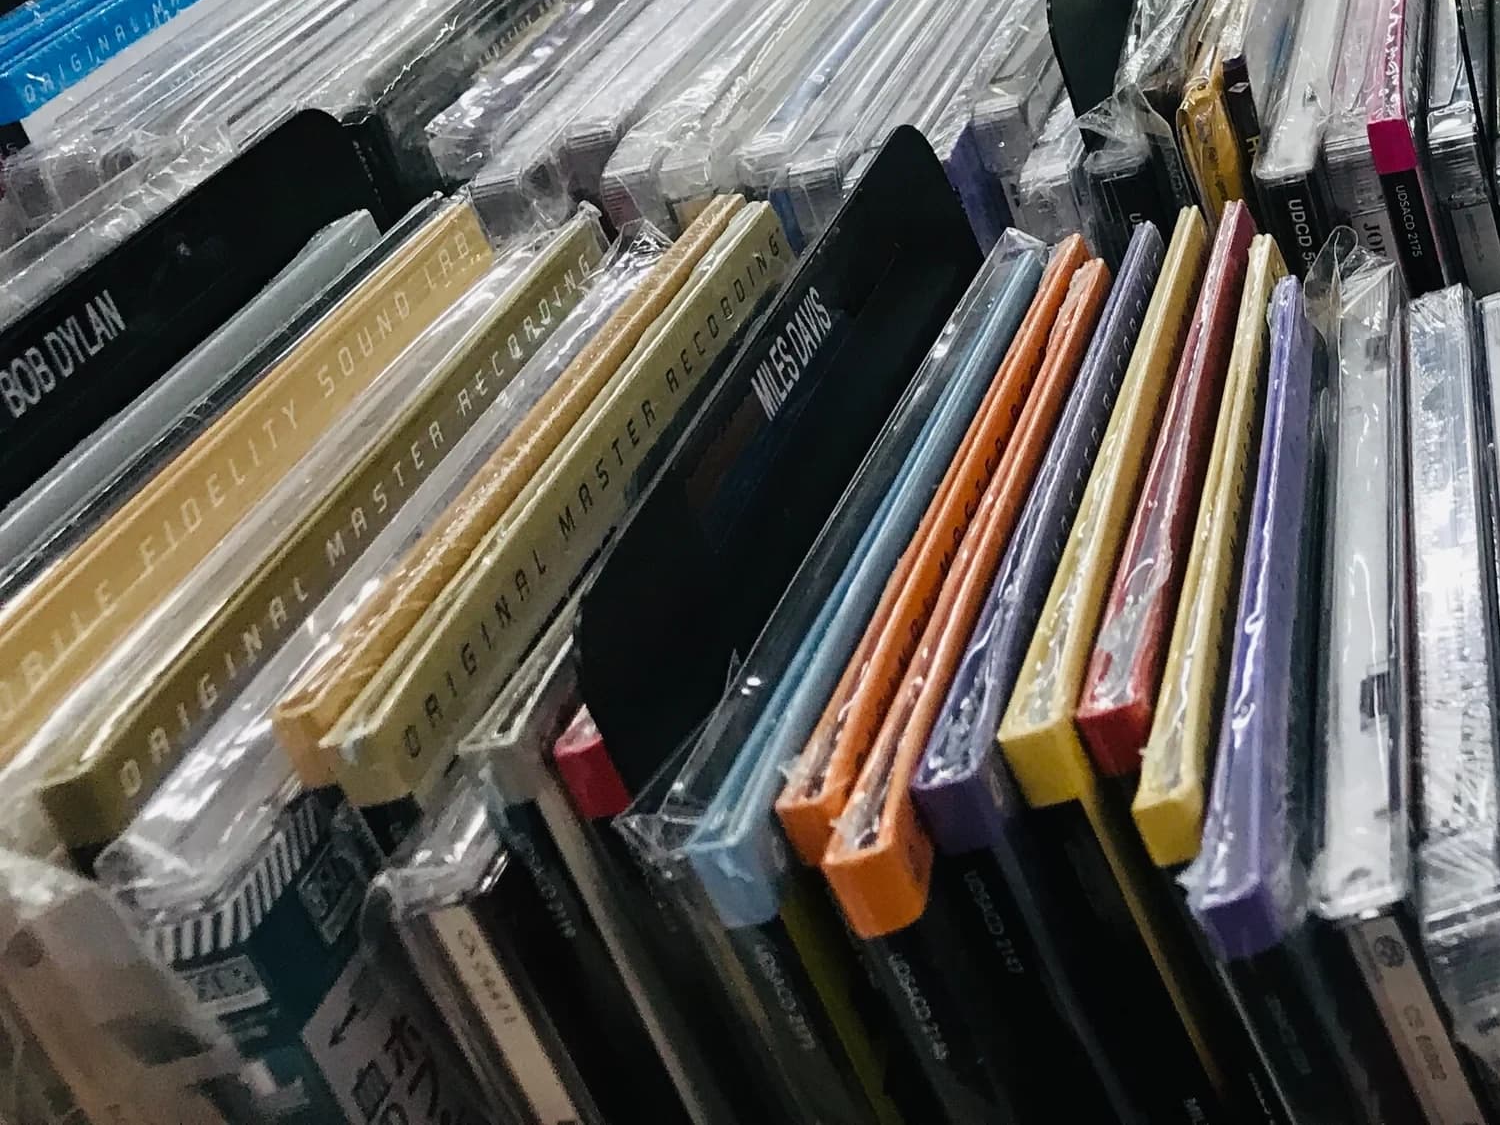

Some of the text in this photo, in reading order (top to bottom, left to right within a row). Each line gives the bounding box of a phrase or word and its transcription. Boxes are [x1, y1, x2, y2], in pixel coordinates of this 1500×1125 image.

[1288, 198, 1313, 248] UDCD
[1395, 183, 1424, 259] UDSACD 2175
[0, 288, 128, 419] BOB DYLAN
[139, 398, 300, 574] FIDELITY
[317, 291, 410, 399] SOUND
[424, 230, 471, 292] LAB
[749, 283, 836, 423] MILES DAVIS
[117, 576, 311, 797] ORIGINAL
[325, 420, 446, 570] MASTER
[456, 253, 594, 417] RECORDING
[402, 546, 549, 761] ORIGINAL
[557, 396, 658, 539] MASTER
